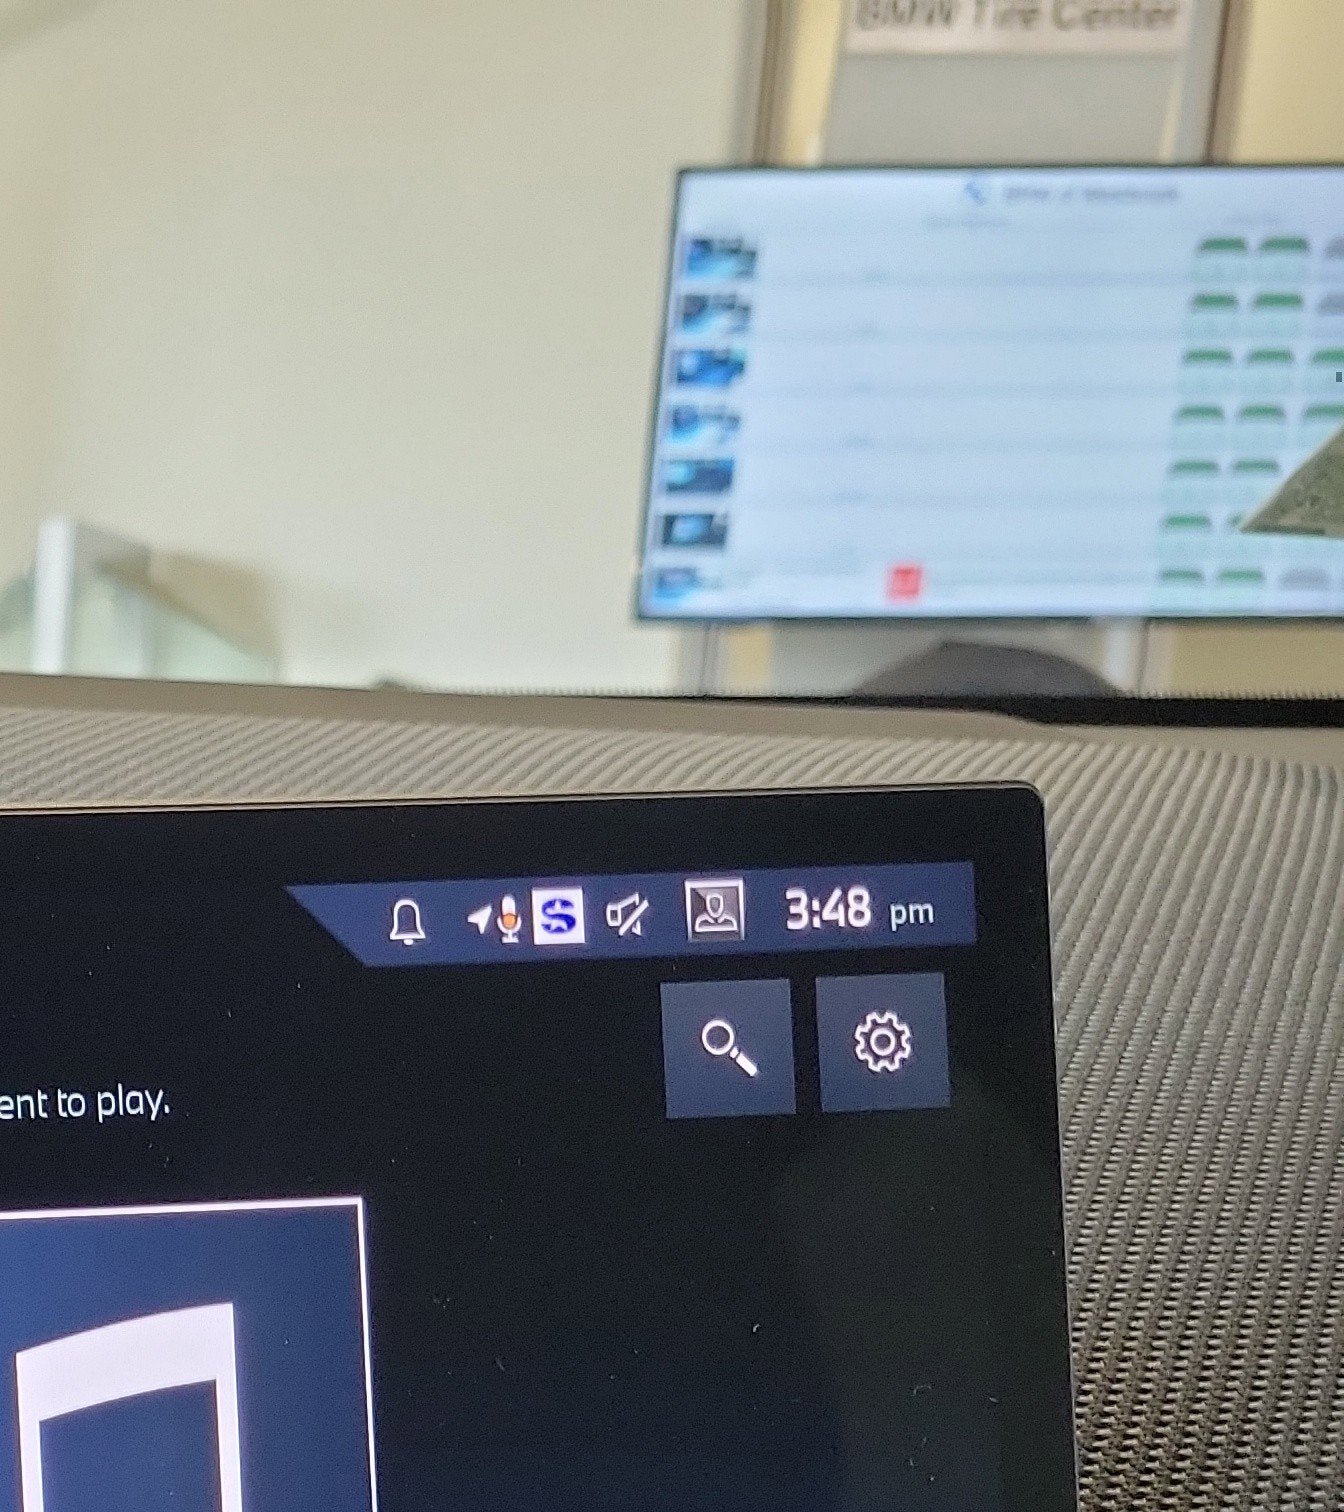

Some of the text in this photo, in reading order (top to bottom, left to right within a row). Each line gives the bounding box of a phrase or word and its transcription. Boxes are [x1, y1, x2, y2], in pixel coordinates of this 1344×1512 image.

[785, 885, 872, 930] 3:48
[890, 903, 934, 932] pm
[57, 1088, 86, 1118] to
[97, 1082, 170, 1124] play.
